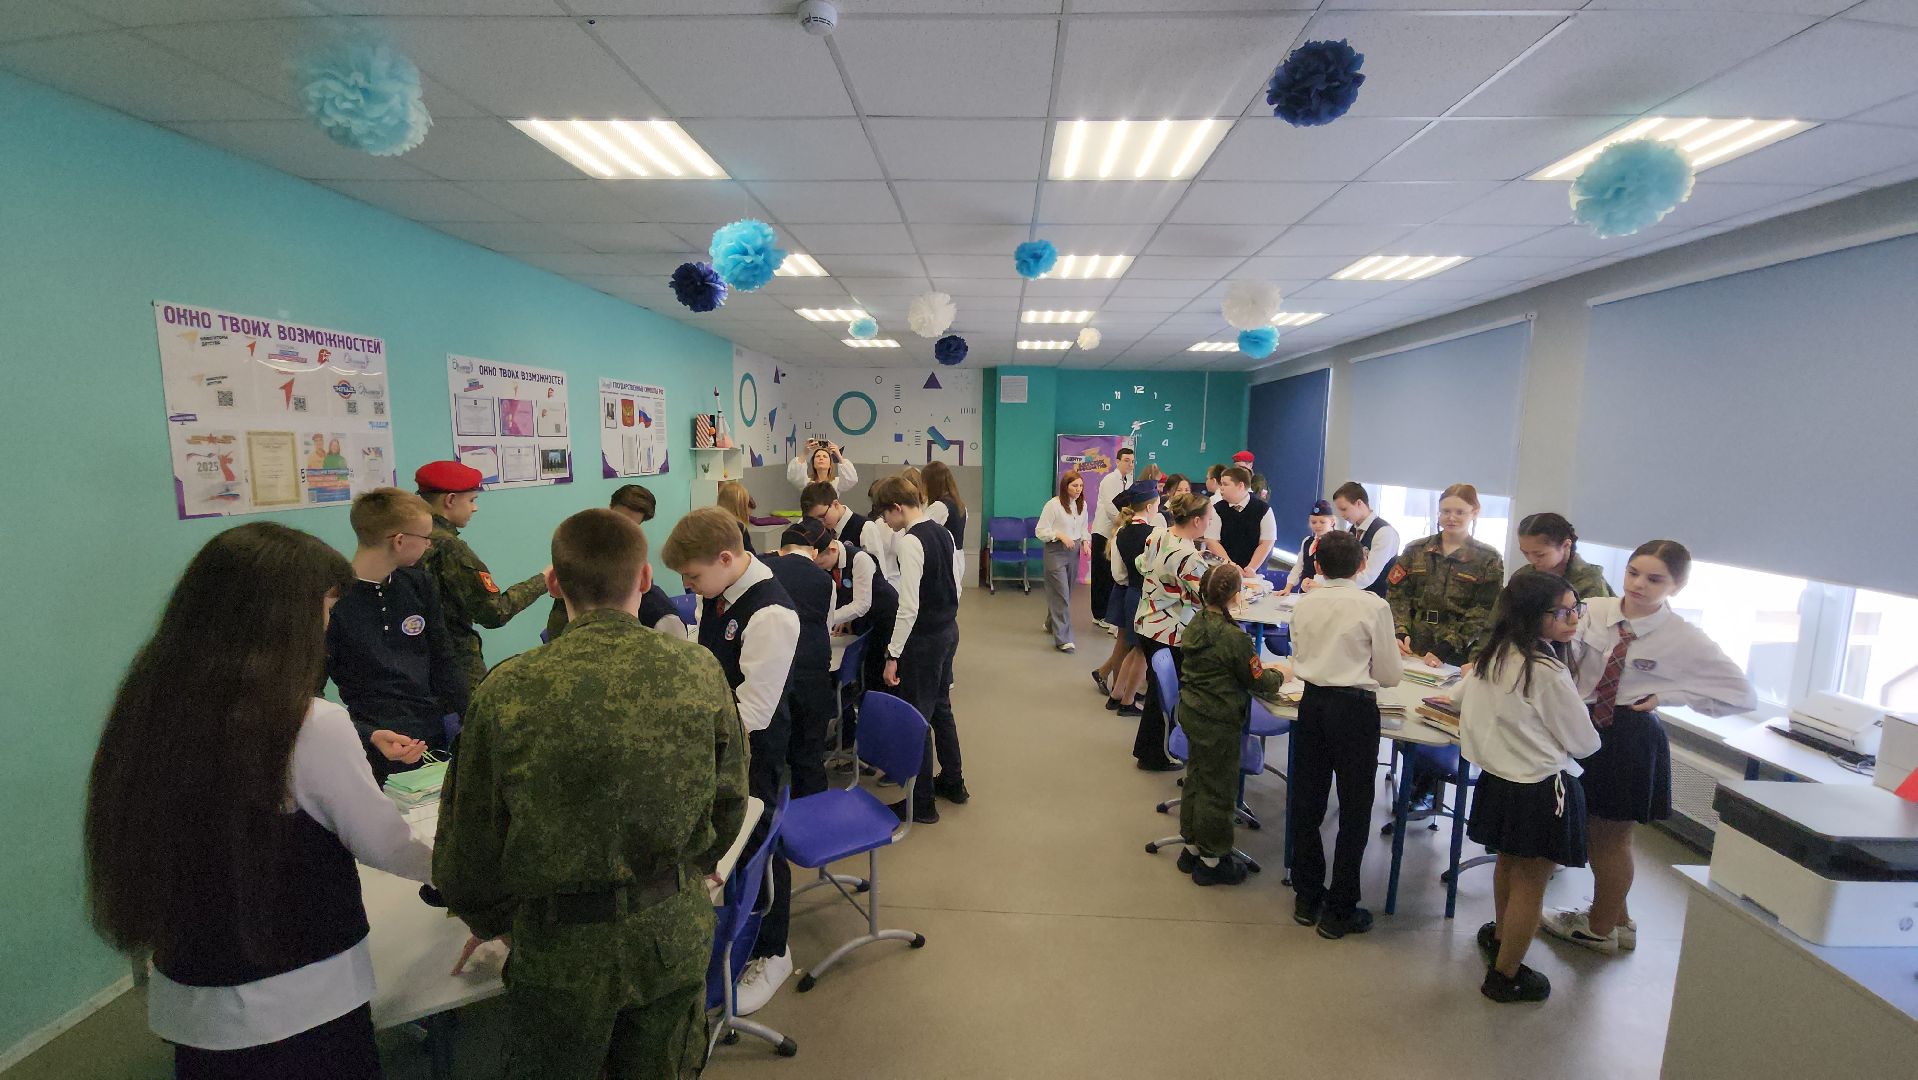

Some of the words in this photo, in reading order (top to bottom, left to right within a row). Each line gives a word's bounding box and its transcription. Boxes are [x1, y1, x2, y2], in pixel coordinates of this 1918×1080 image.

[163, 305, 212, 329] ОКНО
[218, 314, 272, 339] ТВОИХ
[277, 324, 382, 354] ВОЗМОЖНОСТЕЙ
[478, 364, 497, 377] ОКНО
[499, 367, 520, 380] ТВОИХ
[1133, 385, 1145, 394] 12
[1114, 390, 1121, 400] 11
[1101, 403, 1111, 411] 10
[1164, 403, 1172, 412] 2
[1098, 420, 1105, 429] 9
[1166, 422, 1174, 430] 3
[1161, 439, 1169, 447] 4
[196, 461, 219, 473] 2025
